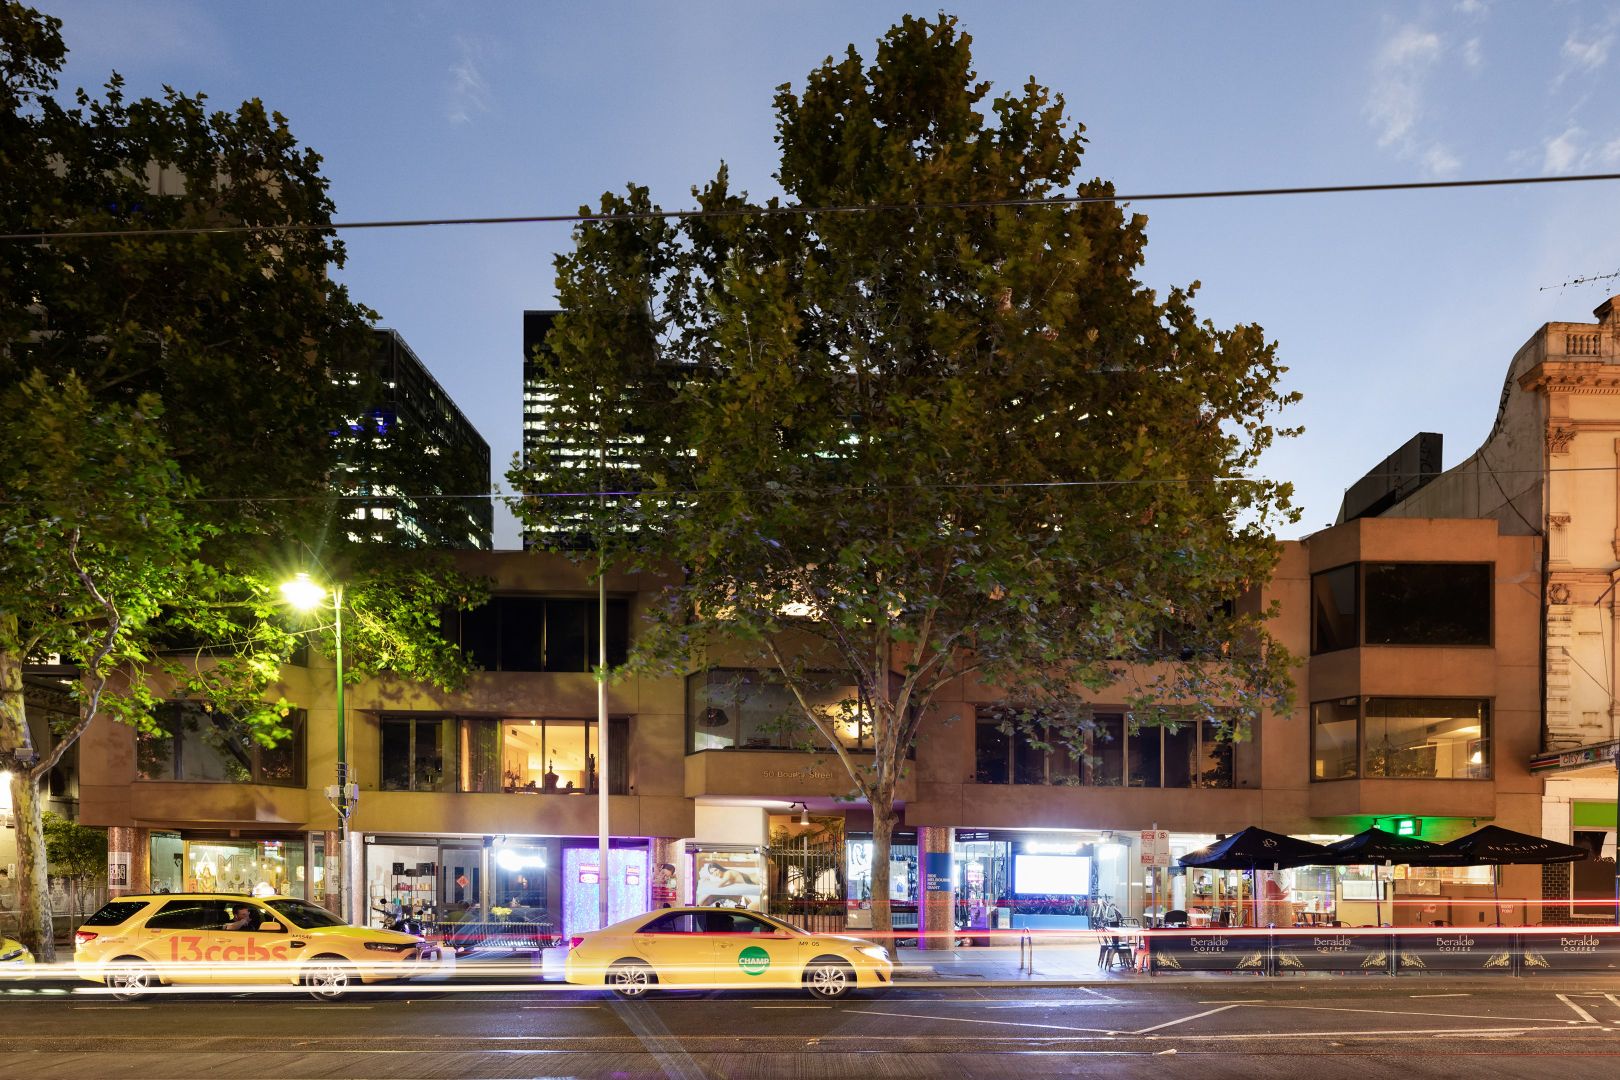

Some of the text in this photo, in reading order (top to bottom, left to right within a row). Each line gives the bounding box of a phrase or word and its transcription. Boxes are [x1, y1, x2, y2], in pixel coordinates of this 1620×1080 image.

[809, 770, 833, 779] Street
[1190, 936, 1228, 946] Beraldo
[1313, 935, 1351, 946] Beraldo
[1436, 935, 1475, 946] Beraldo
[1560, 935, 1599, 946] Beraldo
[169, 936, 288, 961] 13cabs
[739, 957, 770, 965] CHAMP
